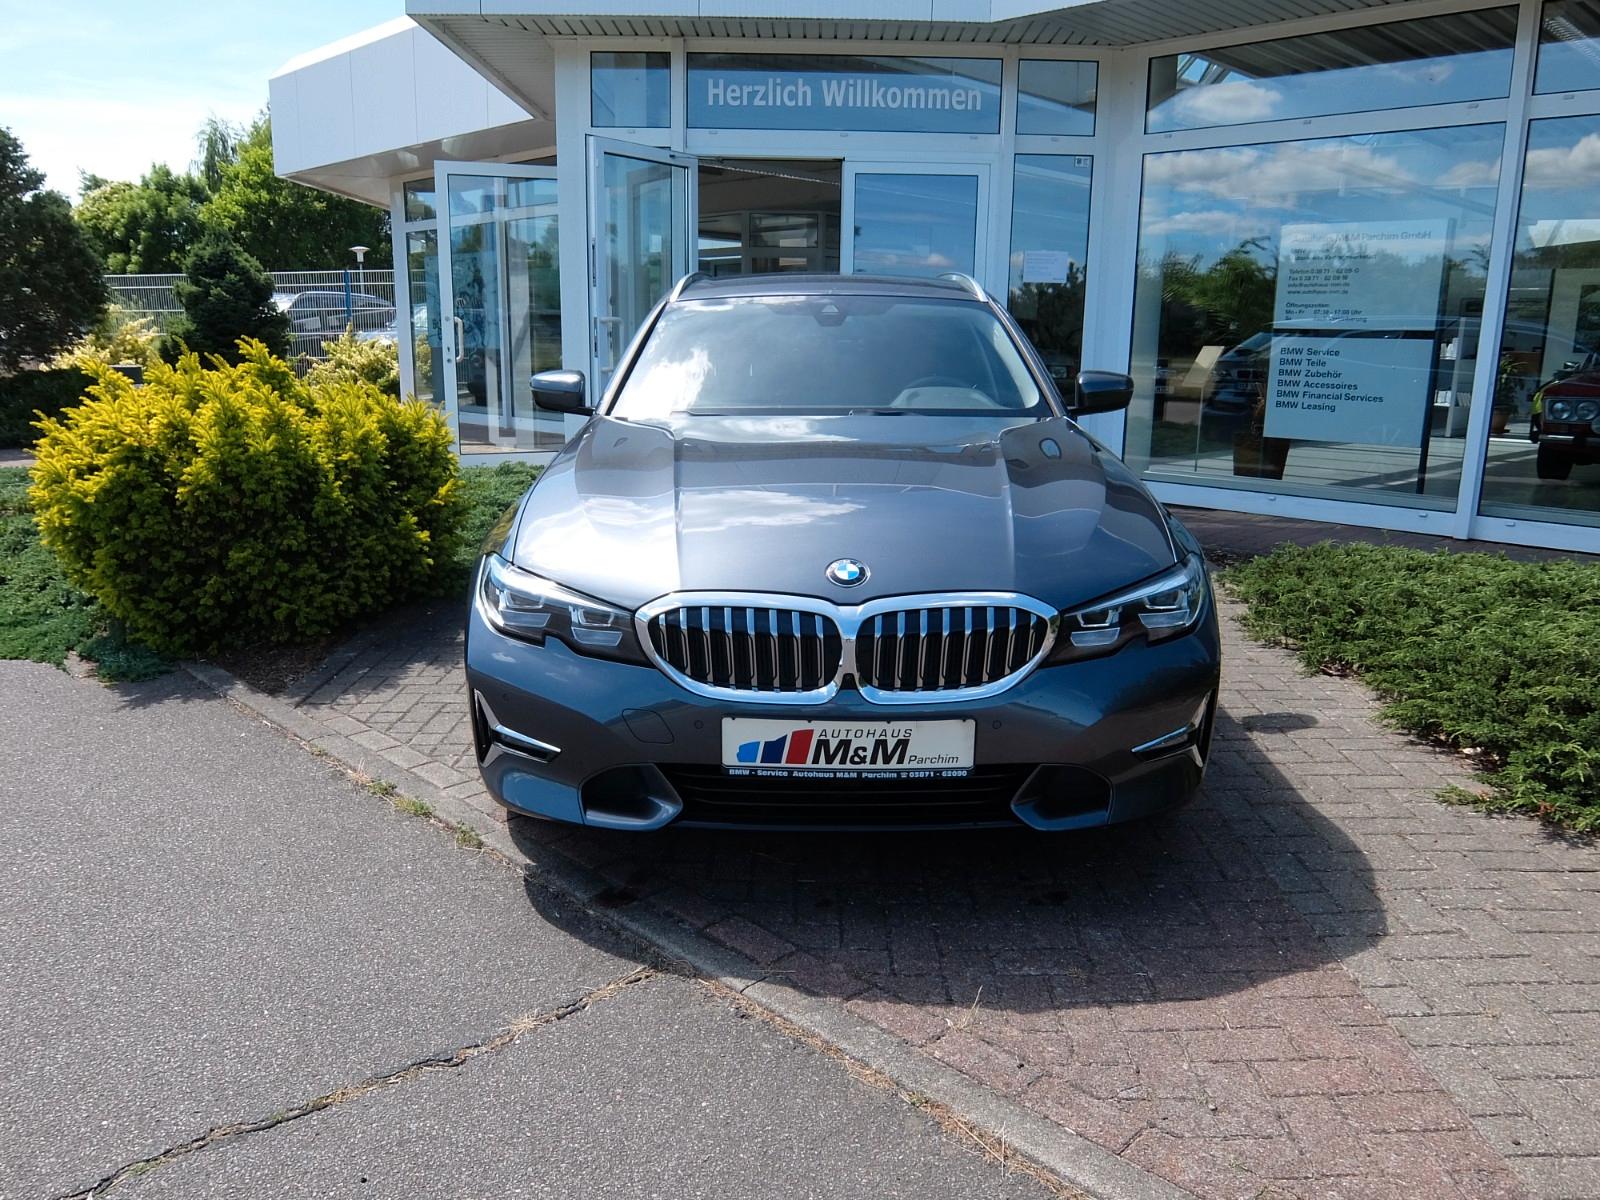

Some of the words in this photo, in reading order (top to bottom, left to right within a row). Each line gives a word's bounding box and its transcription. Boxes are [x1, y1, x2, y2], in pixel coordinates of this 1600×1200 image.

[707, 78, 812, 107] Herzlich
[822, 79, 982, 111] Willkommen
[1400, 231, 1432, 239] GmbH
[1280, 347, 1304, 356] BMW
[1306, 348, 1340, 357] Service
[1279, 358, 1303, 366] BMW
[1306, 358, 1327, 367] Teile
[1278, 368, 1302, 377] BMW
[1304, 369, 1343, 379] Zubehör
[1277, 379, 1301, 388] BMW
[1303, 380, 1359, 391] Accessoires
[1276, 389, 1300, 398] BMW
[1302, 390, 1342, 401] Financial
[1344, 392, 1384, 403] Services
[1275, 400, 1299, 409] BMW
[1301, 402, 1336, 413] Leasing
[818, 728, 913, 739] AUTOHAUS
[811, 738, 911, 766] M&M
[907, 753, 961, 765] Parchim
[756, 769, 789, 777] Service
[792, 770, 834, 778] Autohaus
[836, 771, 857, 779] M&M
[861, 771, 897, 779] Parchim
